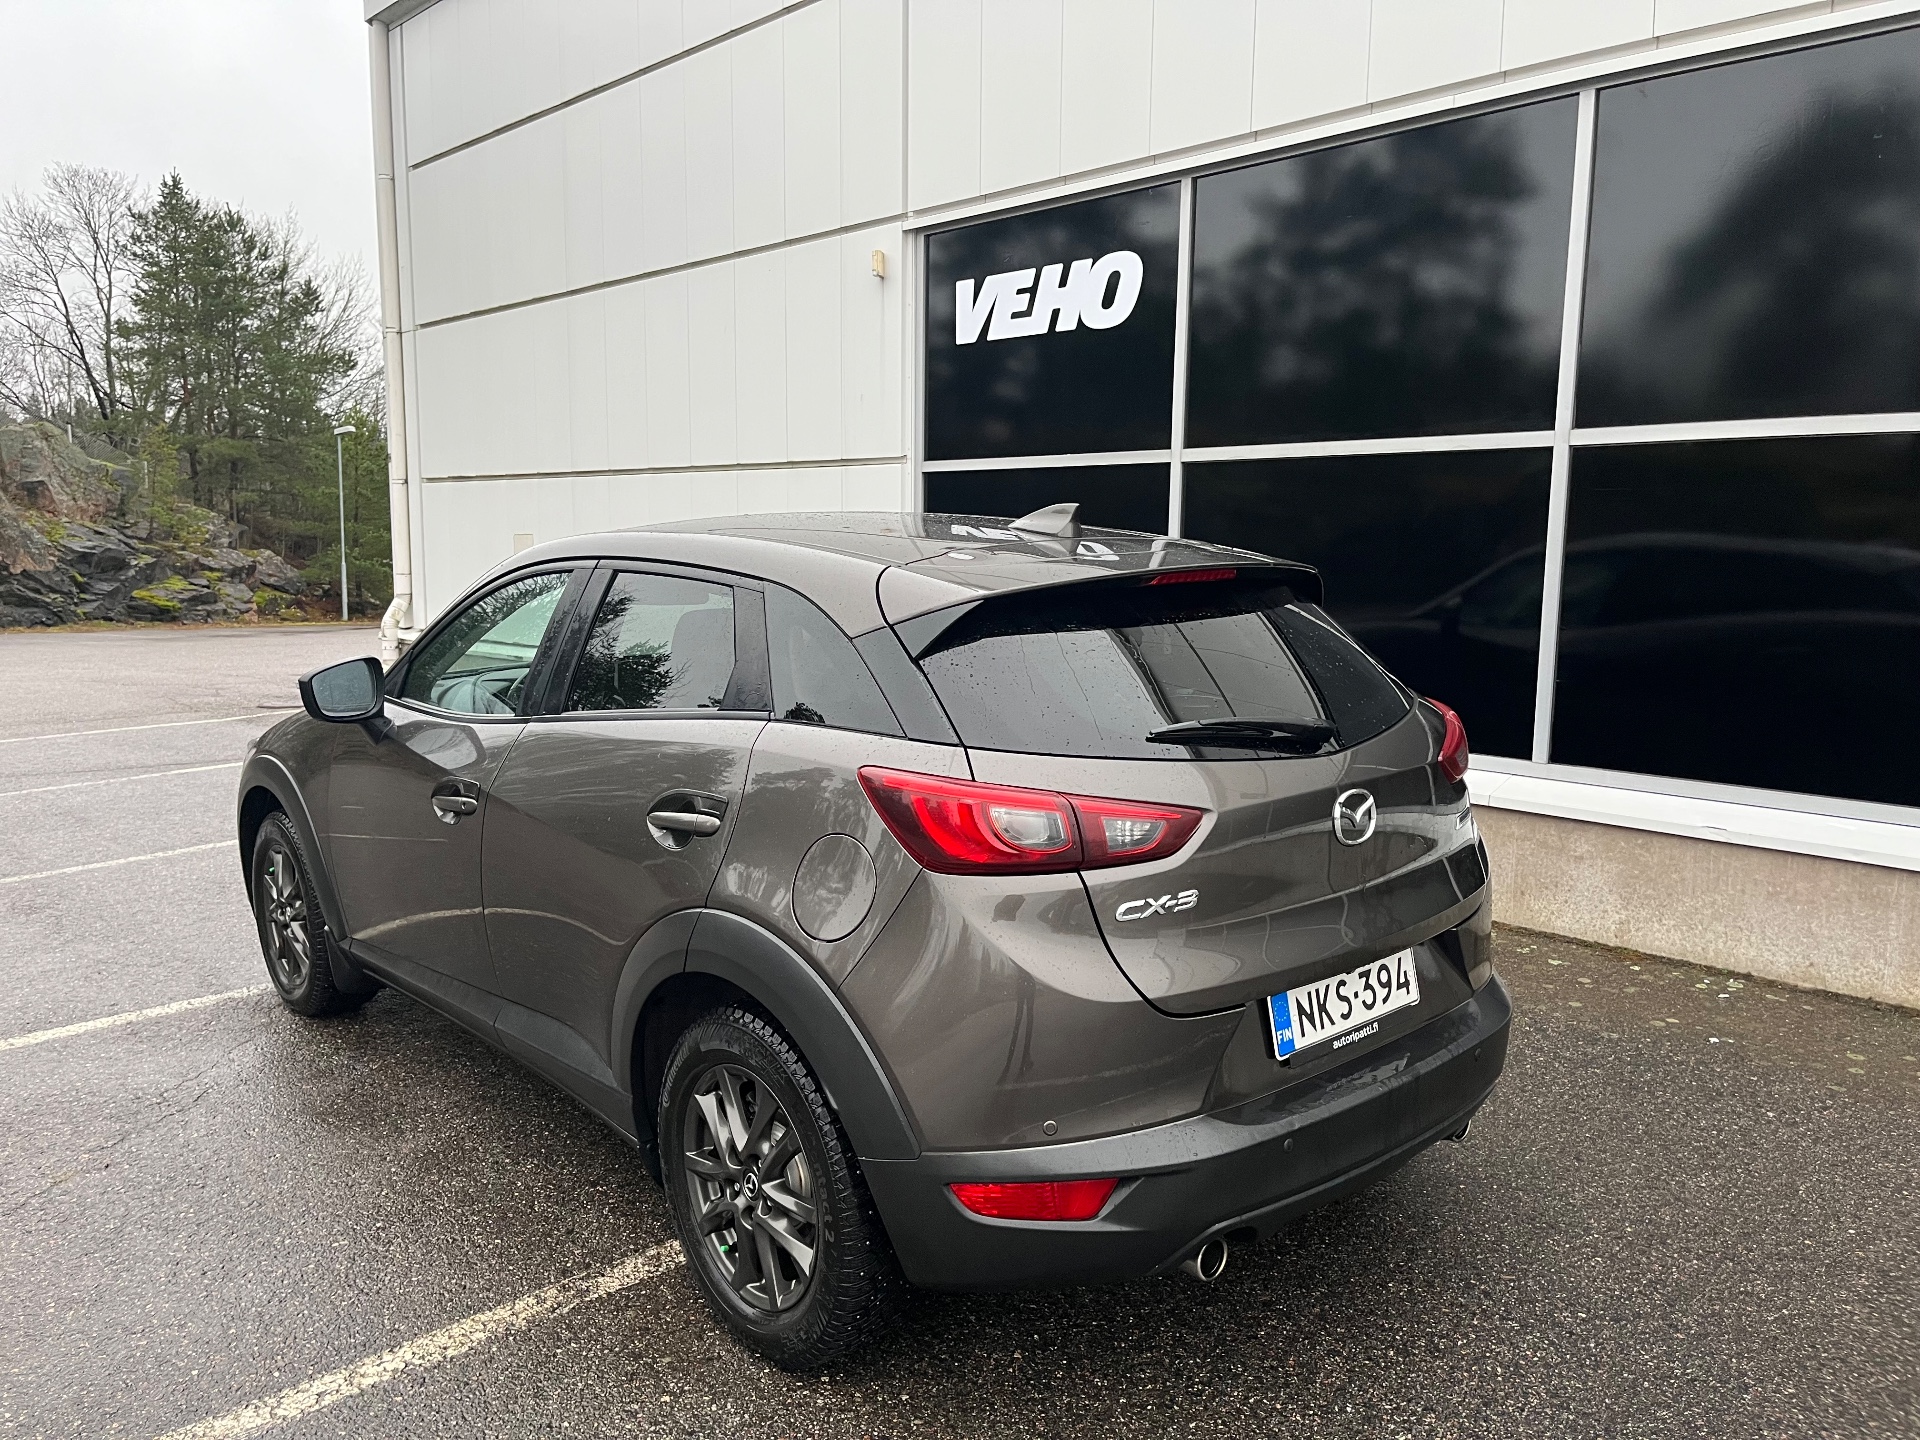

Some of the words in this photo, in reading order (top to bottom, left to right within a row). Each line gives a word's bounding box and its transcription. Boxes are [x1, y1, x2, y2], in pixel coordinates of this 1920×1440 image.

[955, 250, 1144, 345] VEHO
[1115, 889, 1199, 922] CX-3
[1295, 957, 1411, 1038] NKS-394
[1276, 1027, 1293, 1045] FIN
[1332, 1022, 1379, 1049] autoripatti.fi
